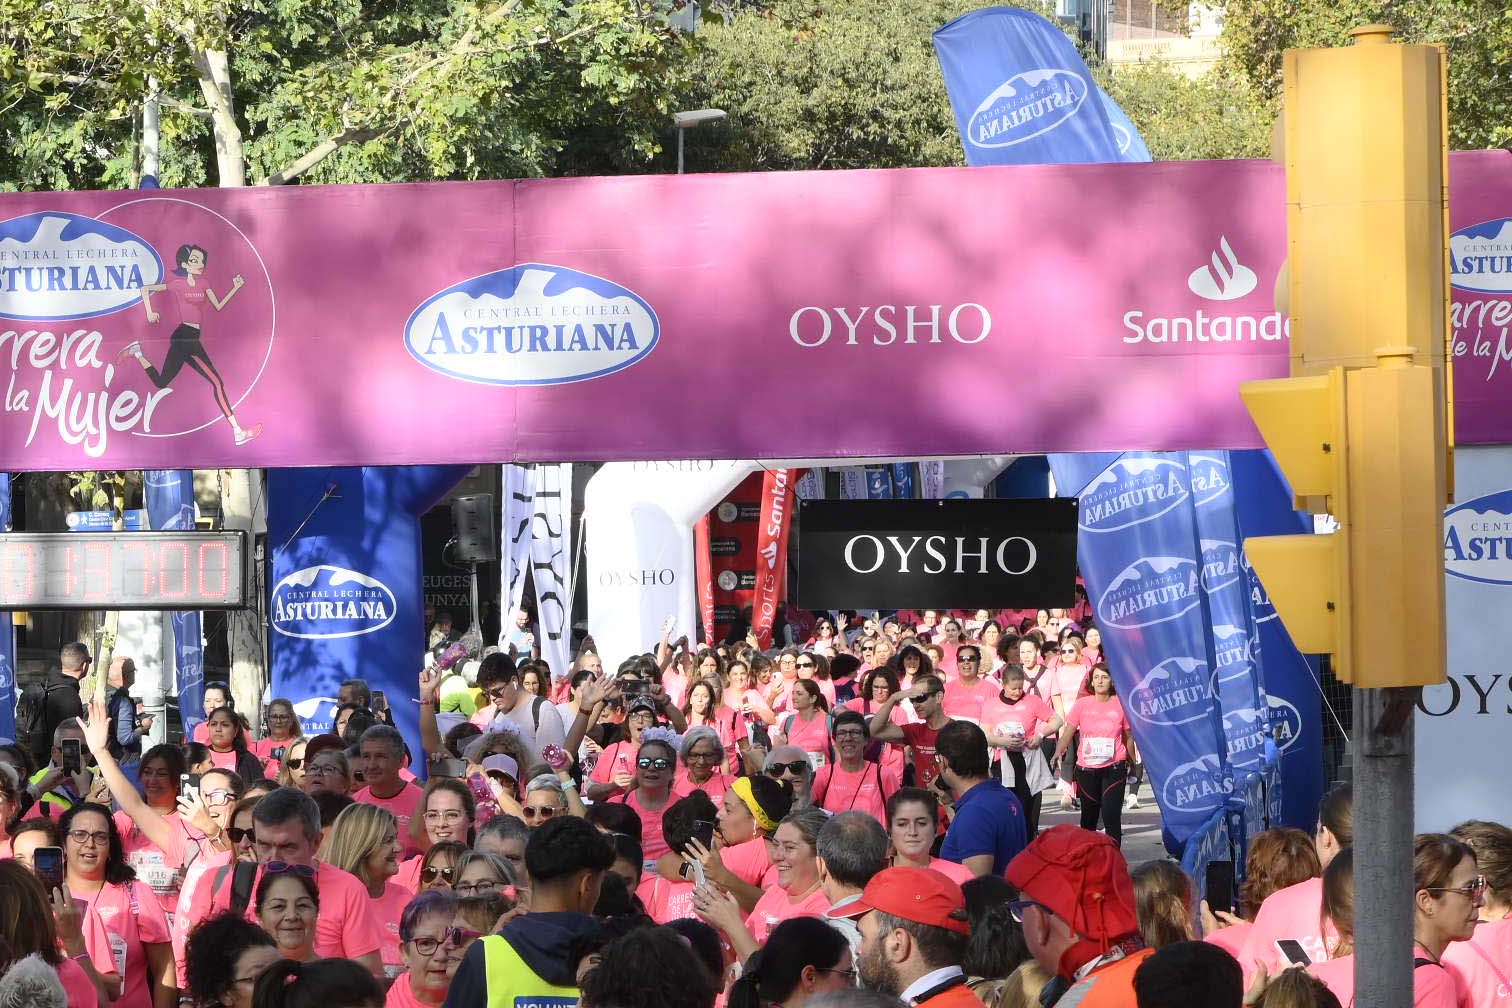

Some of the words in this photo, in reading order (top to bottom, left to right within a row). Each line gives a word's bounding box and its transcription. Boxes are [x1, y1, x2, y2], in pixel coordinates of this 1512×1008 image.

[67, 247, 139, 260] LECHERA
[464, 306, 543, 320] CENTRAL
[551, 304, 631, 317] LECHERA
[789, 302, 992, 348] OYSHO
[1123, 308, 1291, 345] Santand
[424, 311, 641, 355] ASTURIANA
[1473, 328, 1492, 357] la
[5, 371, 30, 412] la
[24, 363, 174, 458] Mujer
[843, 534, 1038, 575] OYSHO
[599, 568, 676, 587] OYSHO
[274, 594, 389, 623] ASTURIANA
[287, 590, 330, 600] CENTRAL
[333, 589, 384, 600] LECHERA
[301, 721, 331, 731] NTRAL
